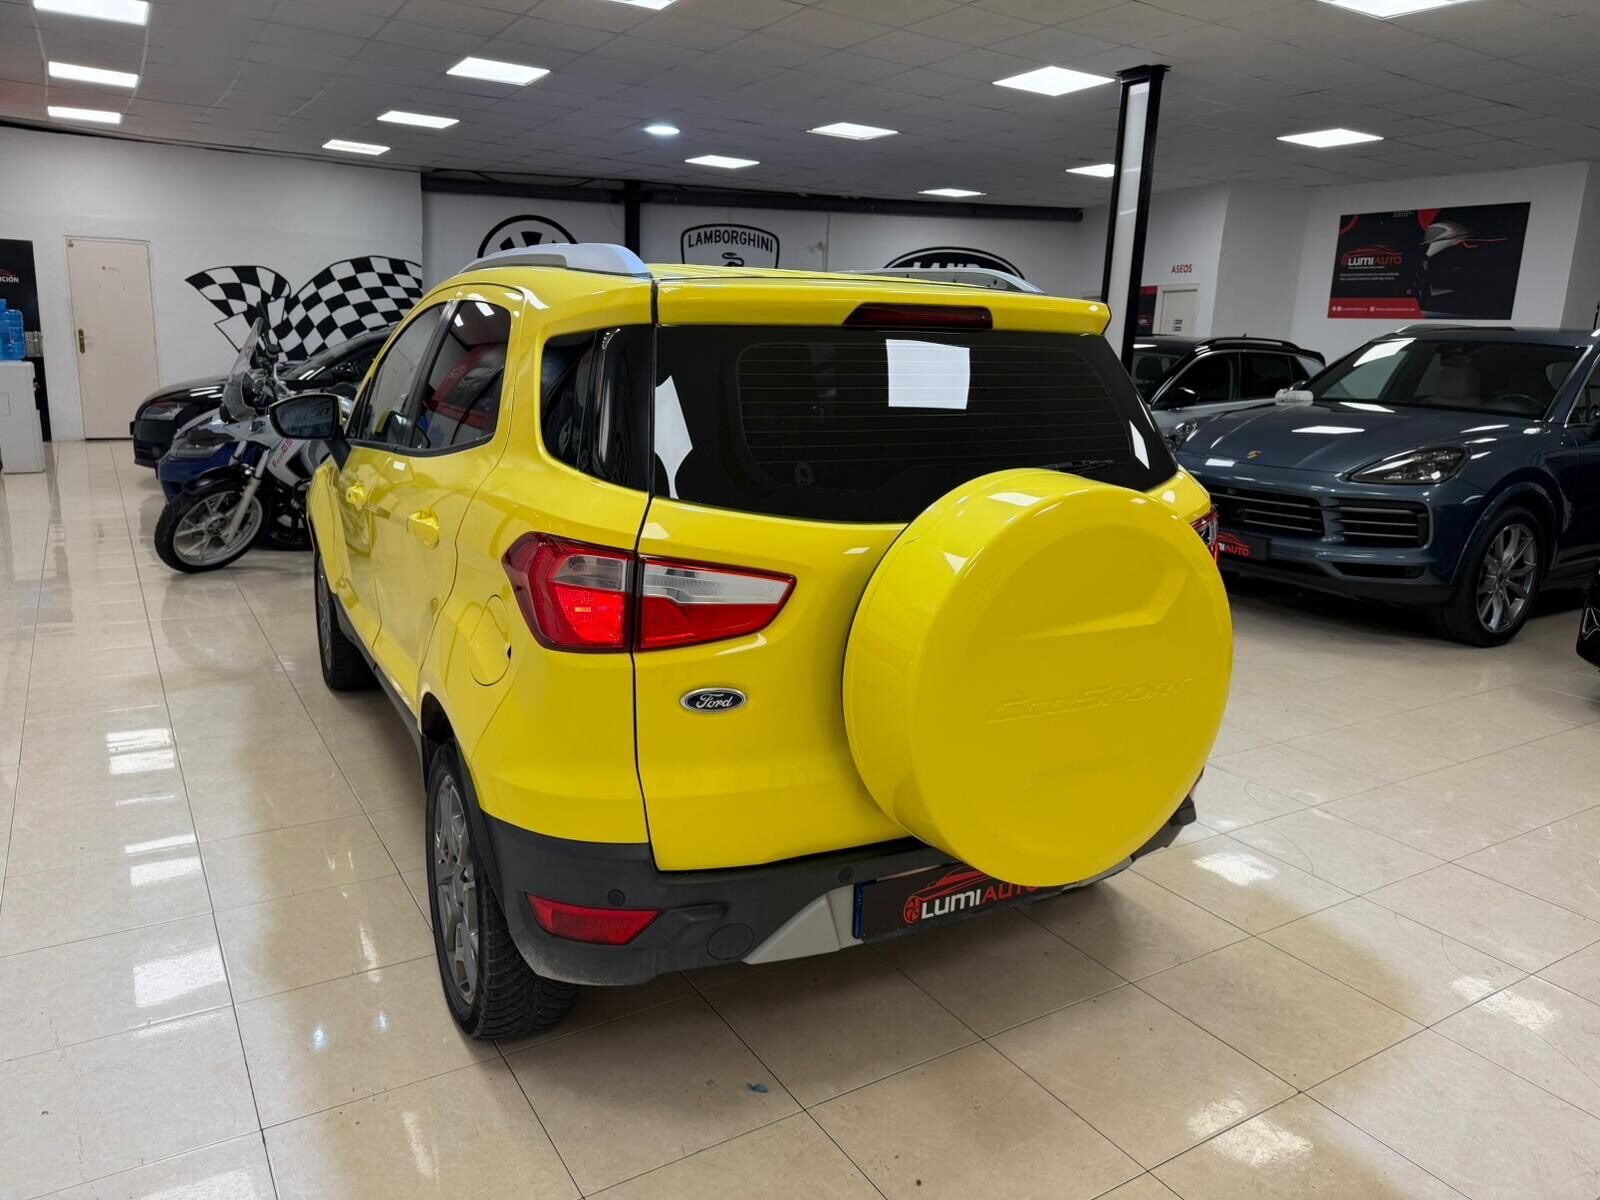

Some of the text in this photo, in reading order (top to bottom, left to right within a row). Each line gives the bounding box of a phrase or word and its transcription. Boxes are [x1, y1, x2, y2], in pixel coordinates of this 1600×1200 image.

[688, 229, 773, 253] LAMBORGHINI
[1171, 264, 1193, 273] ASEOS
[696, 694, 733, 708] Ford
